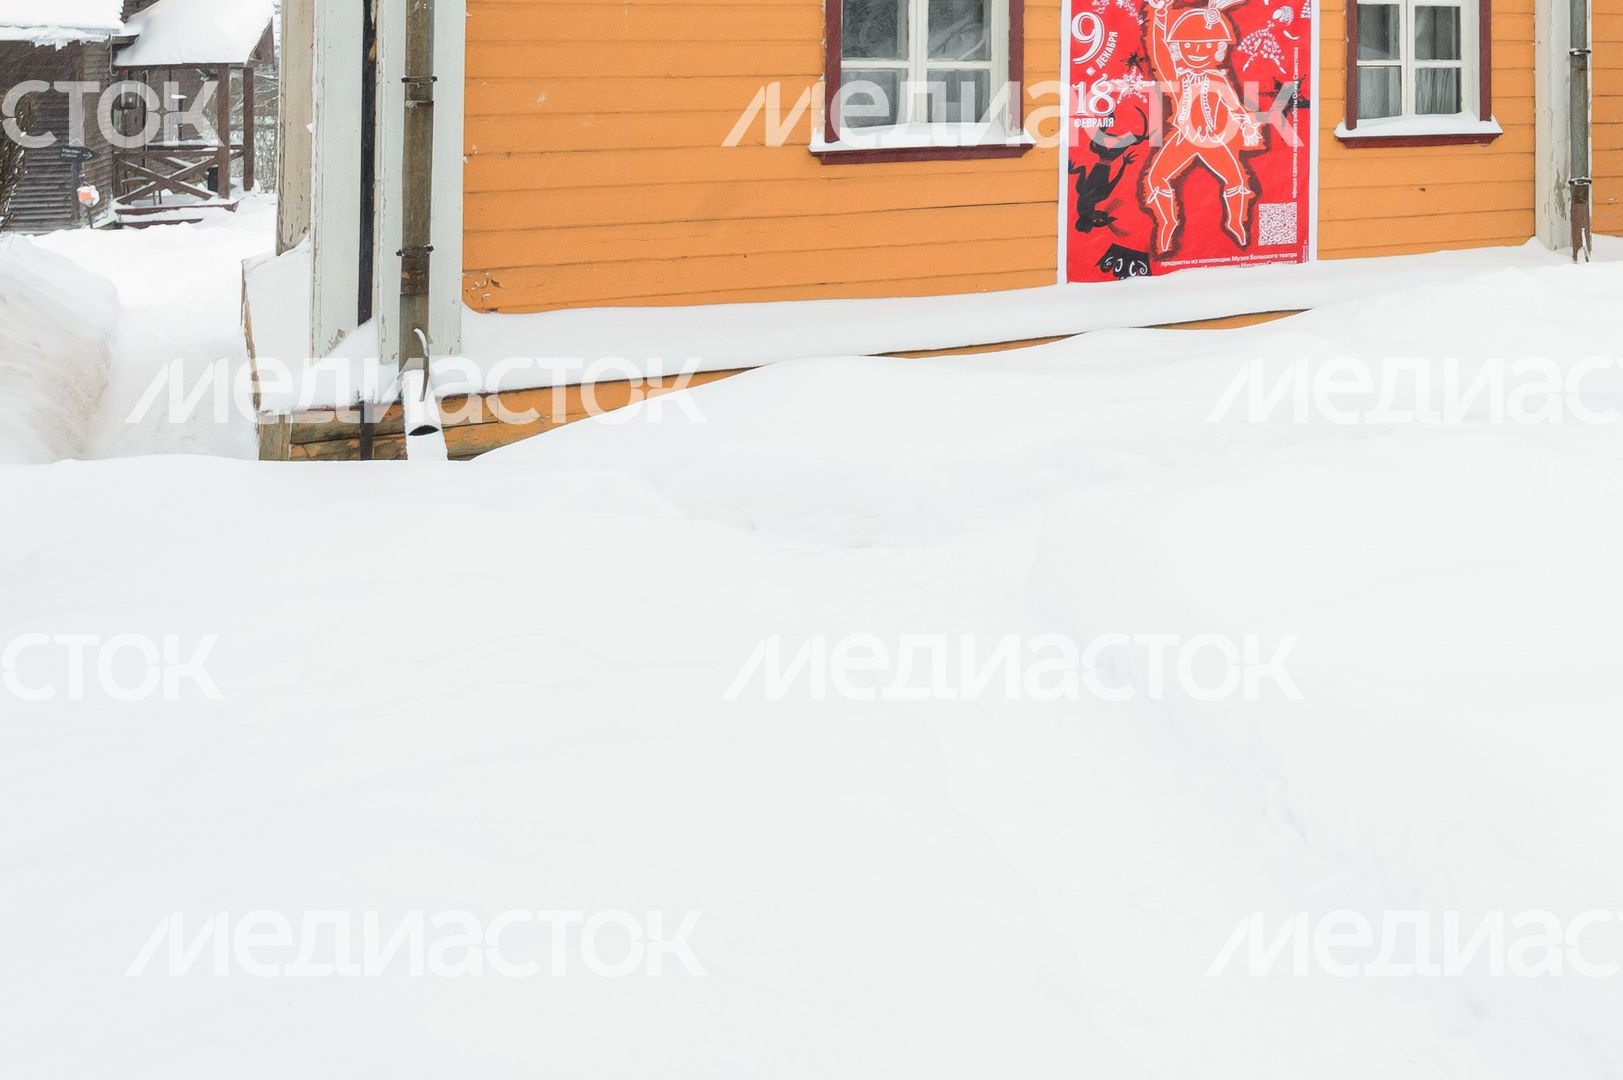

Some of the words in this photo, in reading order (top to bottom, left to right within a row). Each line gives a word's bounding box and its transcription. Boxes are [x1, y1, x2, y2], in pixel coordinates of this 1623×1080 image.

[1071, 11, 1105, 65] 9
[1095, 31, 1118, 69] ДЕКАБРЯ
[1072, 73, 1116, 116] 18
[1074, 117, 1114, 128] ФЕВРАЛЯ
